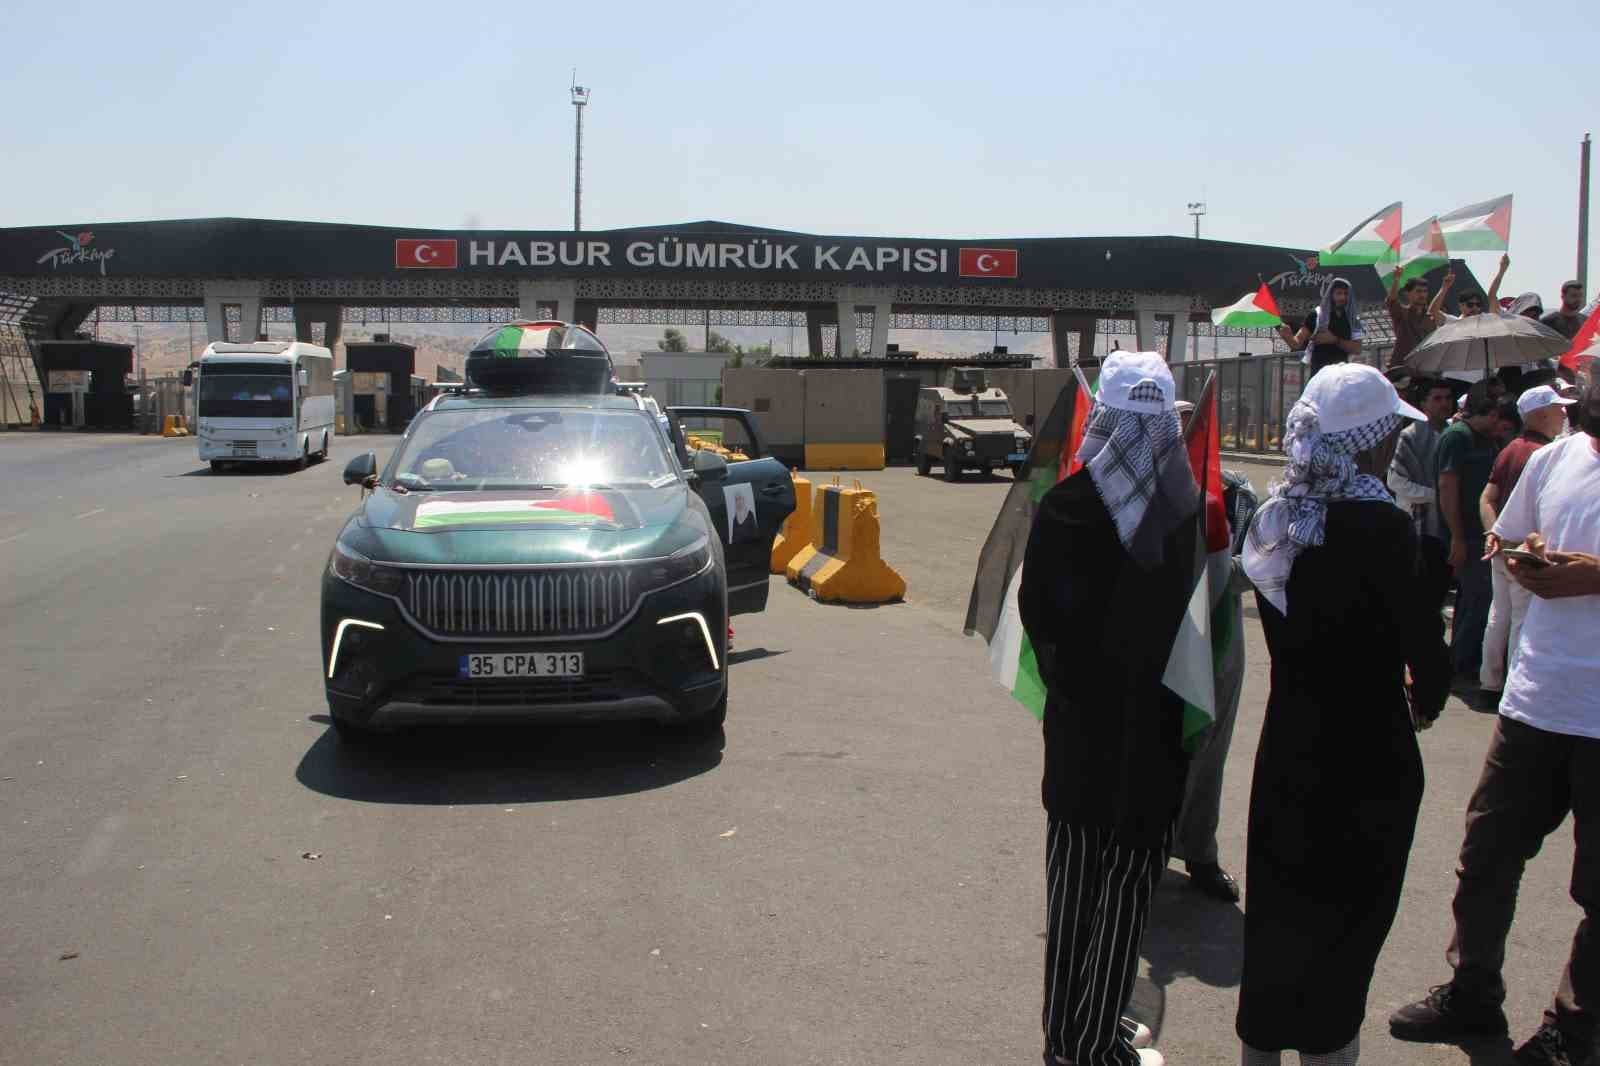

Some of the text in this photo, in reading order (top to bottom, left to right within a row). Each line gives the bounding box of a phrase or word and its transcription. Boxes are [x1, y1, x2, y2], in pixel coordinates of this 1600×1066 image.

[469, 237, 948, 273] HABUR GÜMRÜK KAPISI
[471, 654, 580, 675] 35 CPA 313
